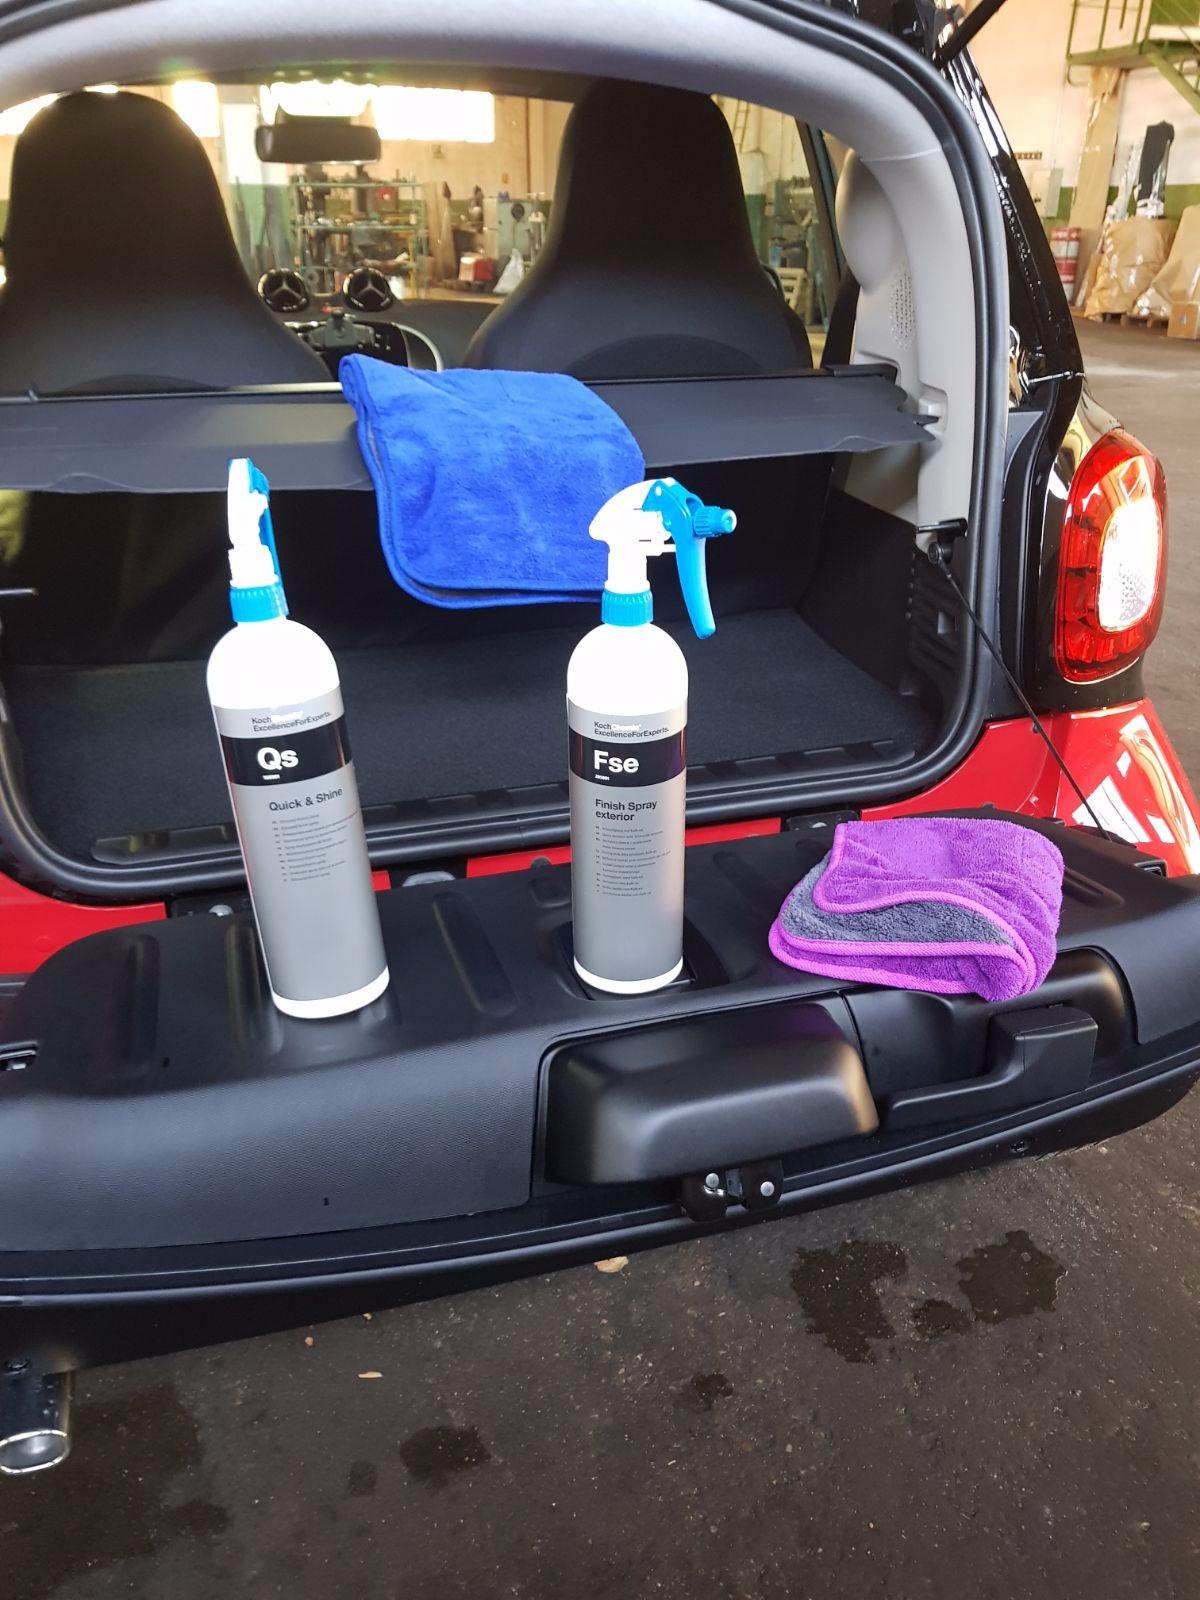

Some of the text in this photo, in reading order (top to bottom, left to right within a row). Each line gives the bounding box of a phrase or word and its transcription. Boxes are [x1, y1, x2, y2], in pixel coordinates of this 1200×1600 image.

[257, 747, 299, 771] Qs
[593, 749, 640, 774] Fse
[269, 788, 343, 811] Quick & Shine
[595, 798, 658, 812] Finish Spray
[595, 811, 635, 821] exterior
